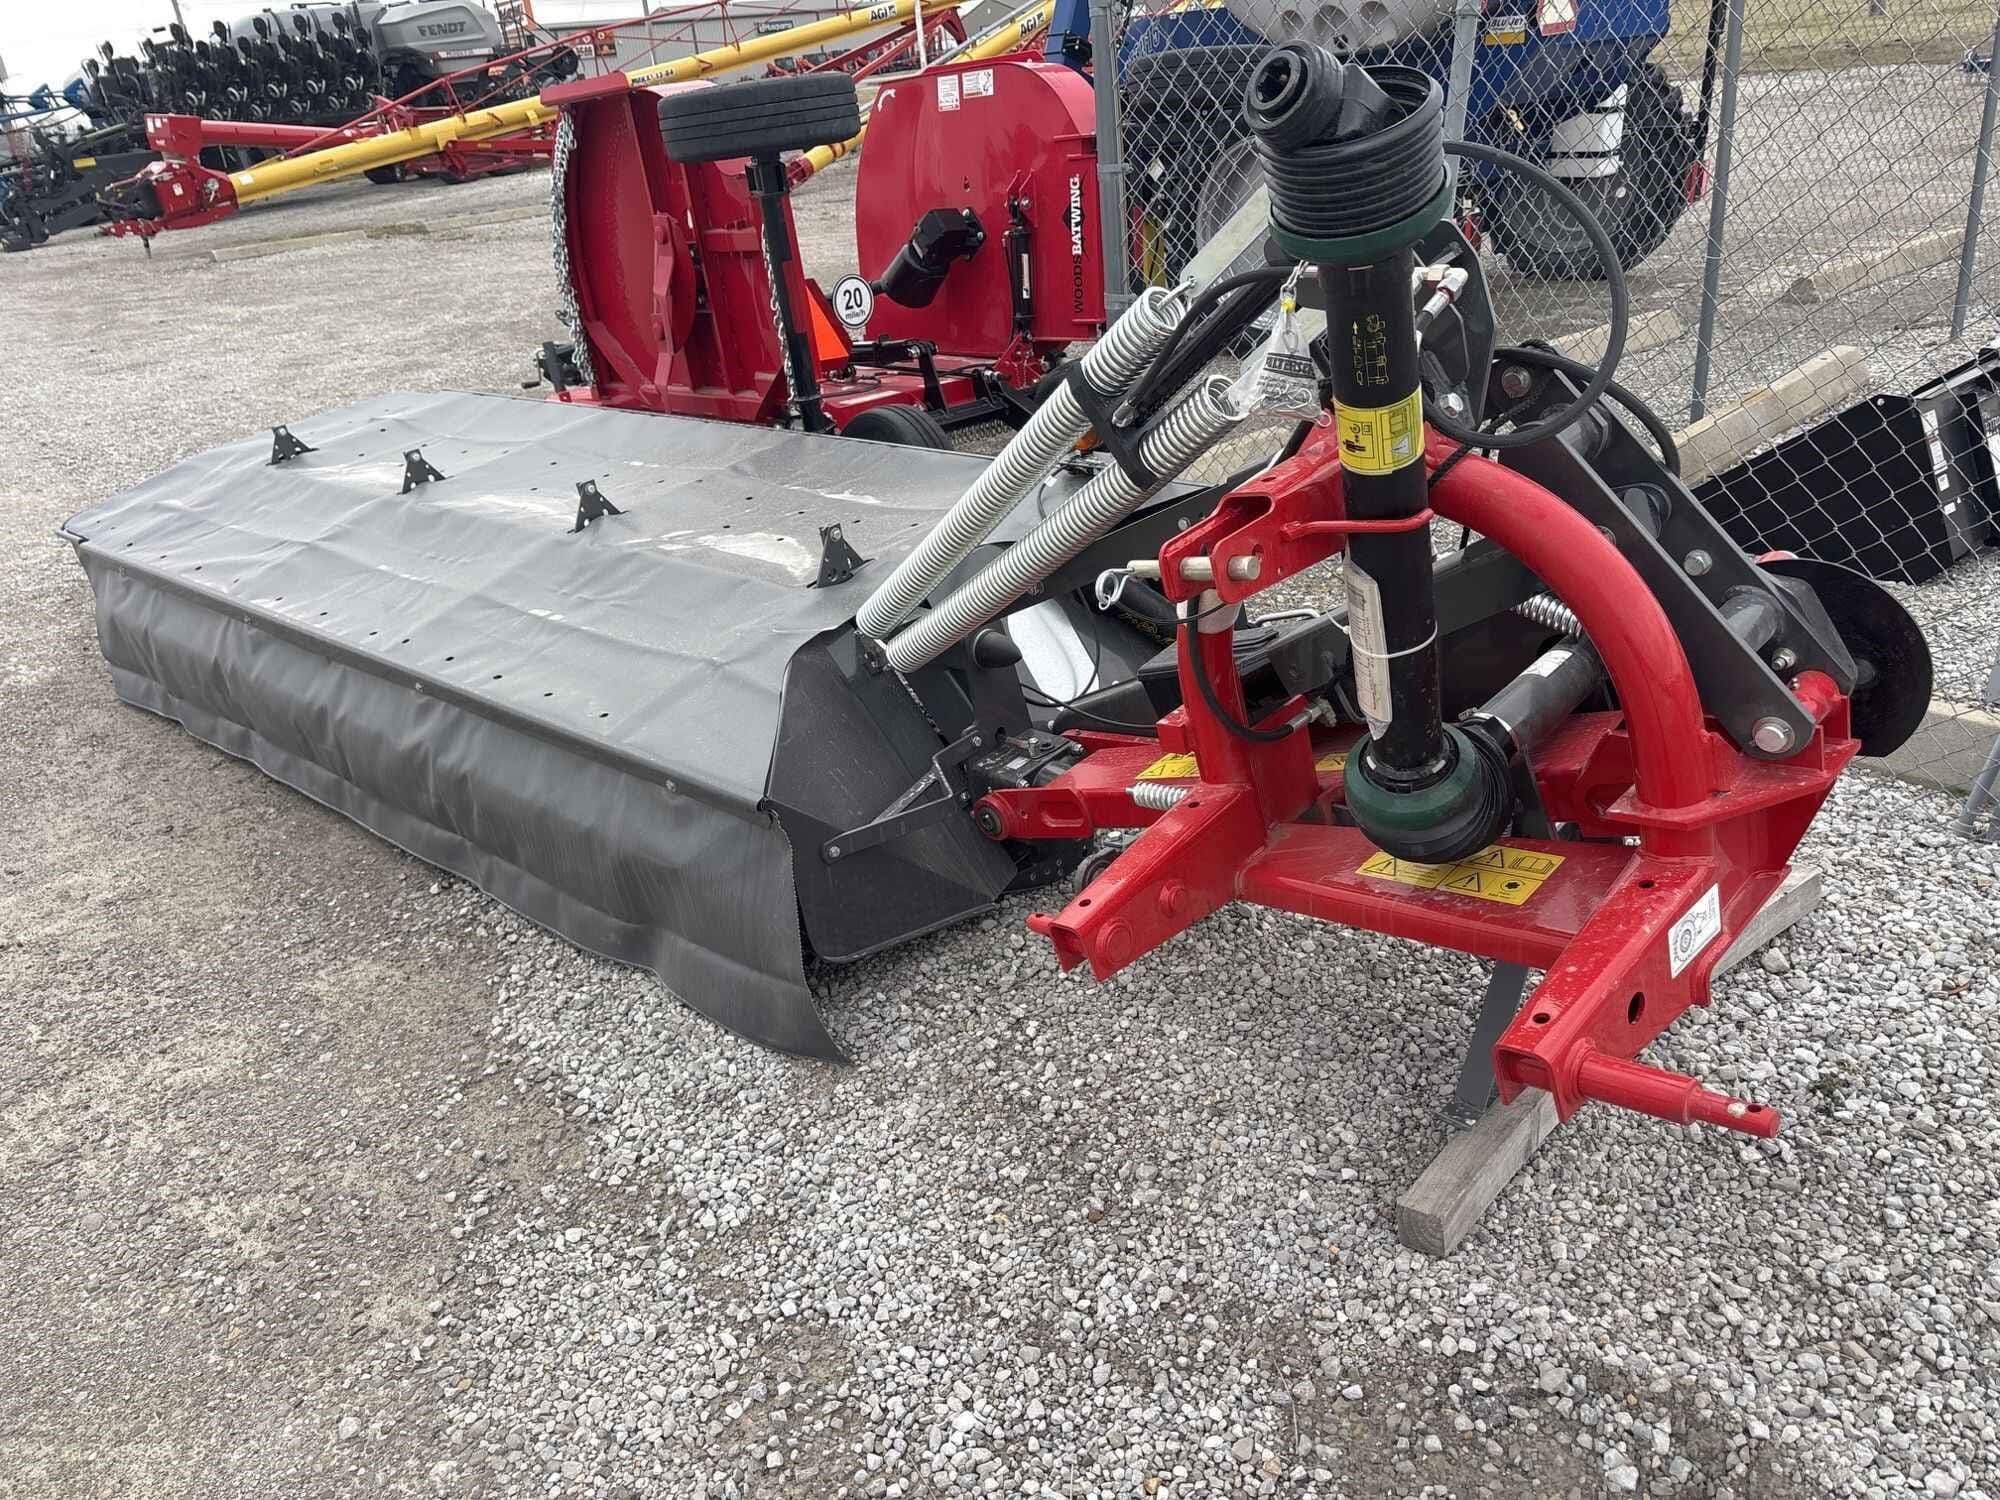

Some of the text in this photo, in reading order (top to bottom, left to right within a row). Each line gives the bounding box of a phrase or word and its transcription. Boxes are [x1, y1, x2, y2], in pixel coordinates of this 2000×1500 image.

[870, 8, 887, 21] AGI
[417, 21, 466, 37] FENDT
[1019, 17, 1036, 36] AGI
[1073, 255, 1083, 314] WOODS
[843, 287, 863, 310] 20
